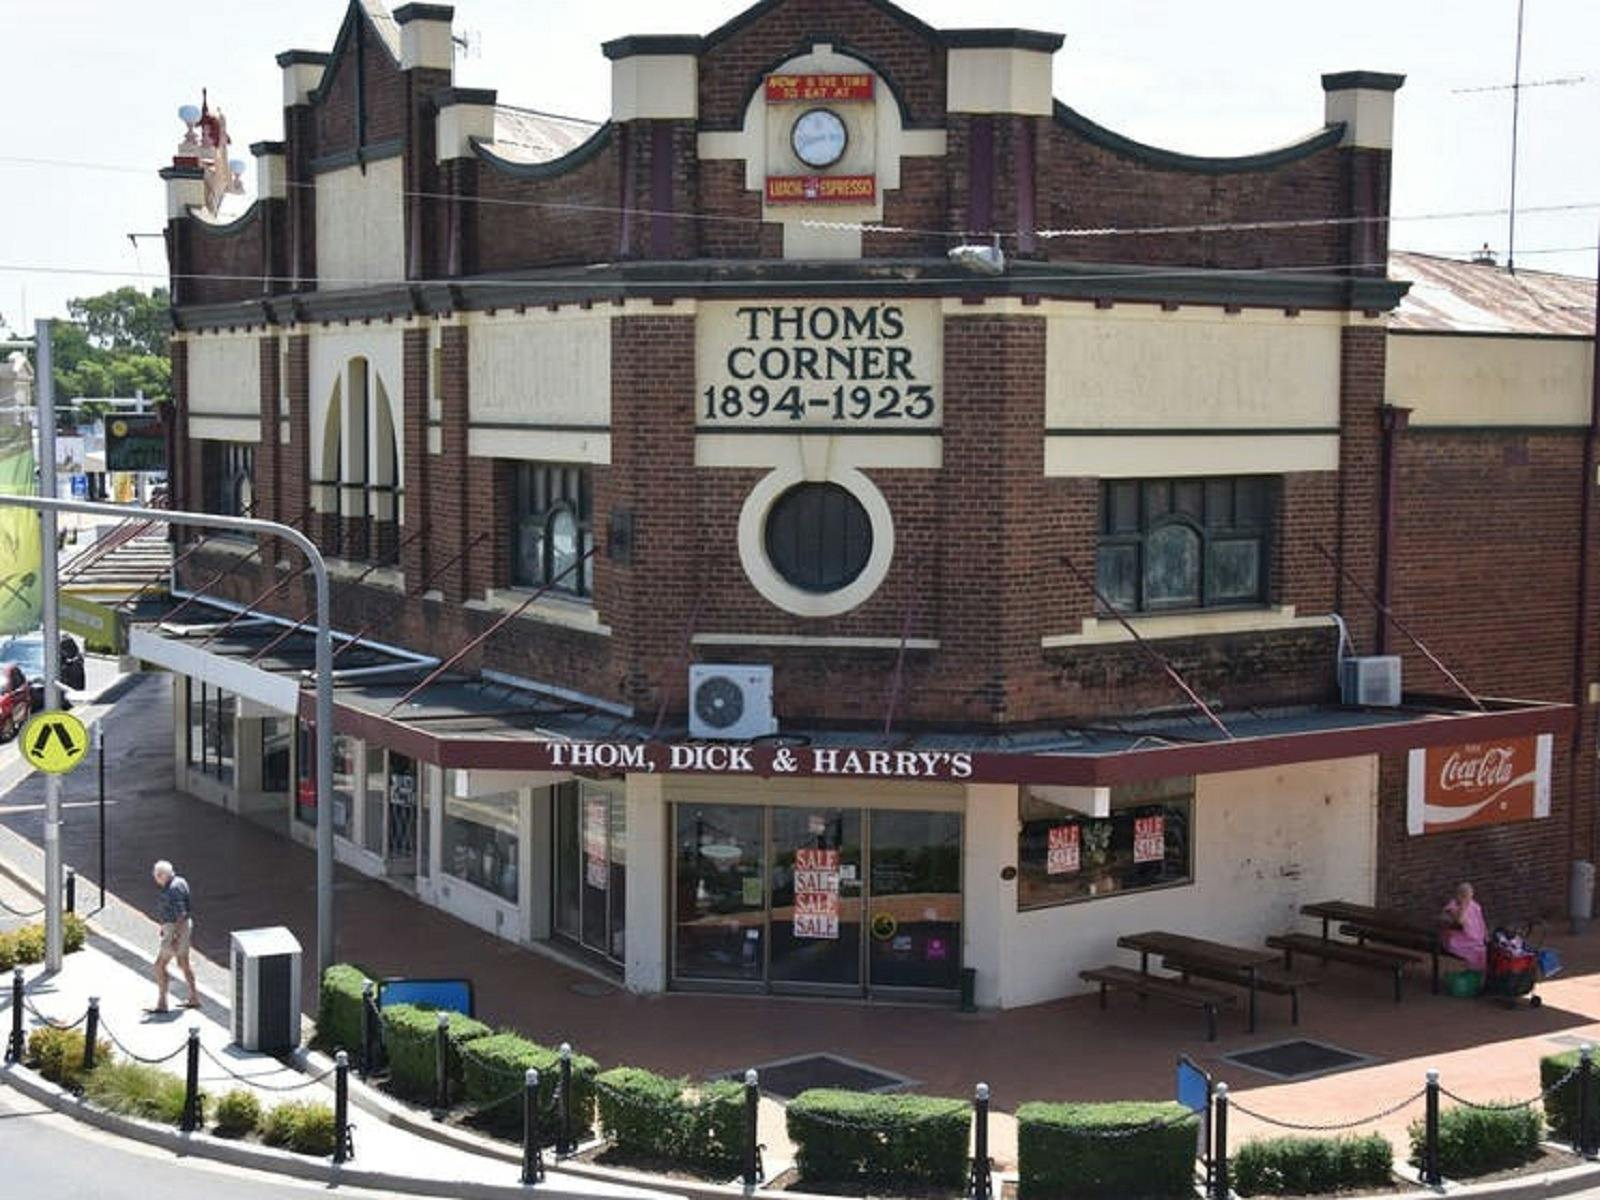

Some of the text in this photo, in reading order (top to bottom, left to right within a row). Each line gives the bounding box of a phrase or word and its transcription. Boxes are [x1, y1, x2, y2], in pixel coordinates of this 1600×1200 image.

[727, 347, 915, 381] CORNER
[703, 385, 935, 420] 1894-1923
[547, 744, 973, 777] THOM, DICK & HARRY'S
[1440, 747, 1516, 791] Coca-Cola
[1049, 826, 1080, 849] SALE
[1135, 817, 1164, 838] SALE
[796, 849, 838, 871] SALE
[796, 872, 838, 892] SALE
[796, 892, 838, 913] SALE
[796, 914, 837, 935] SALE
